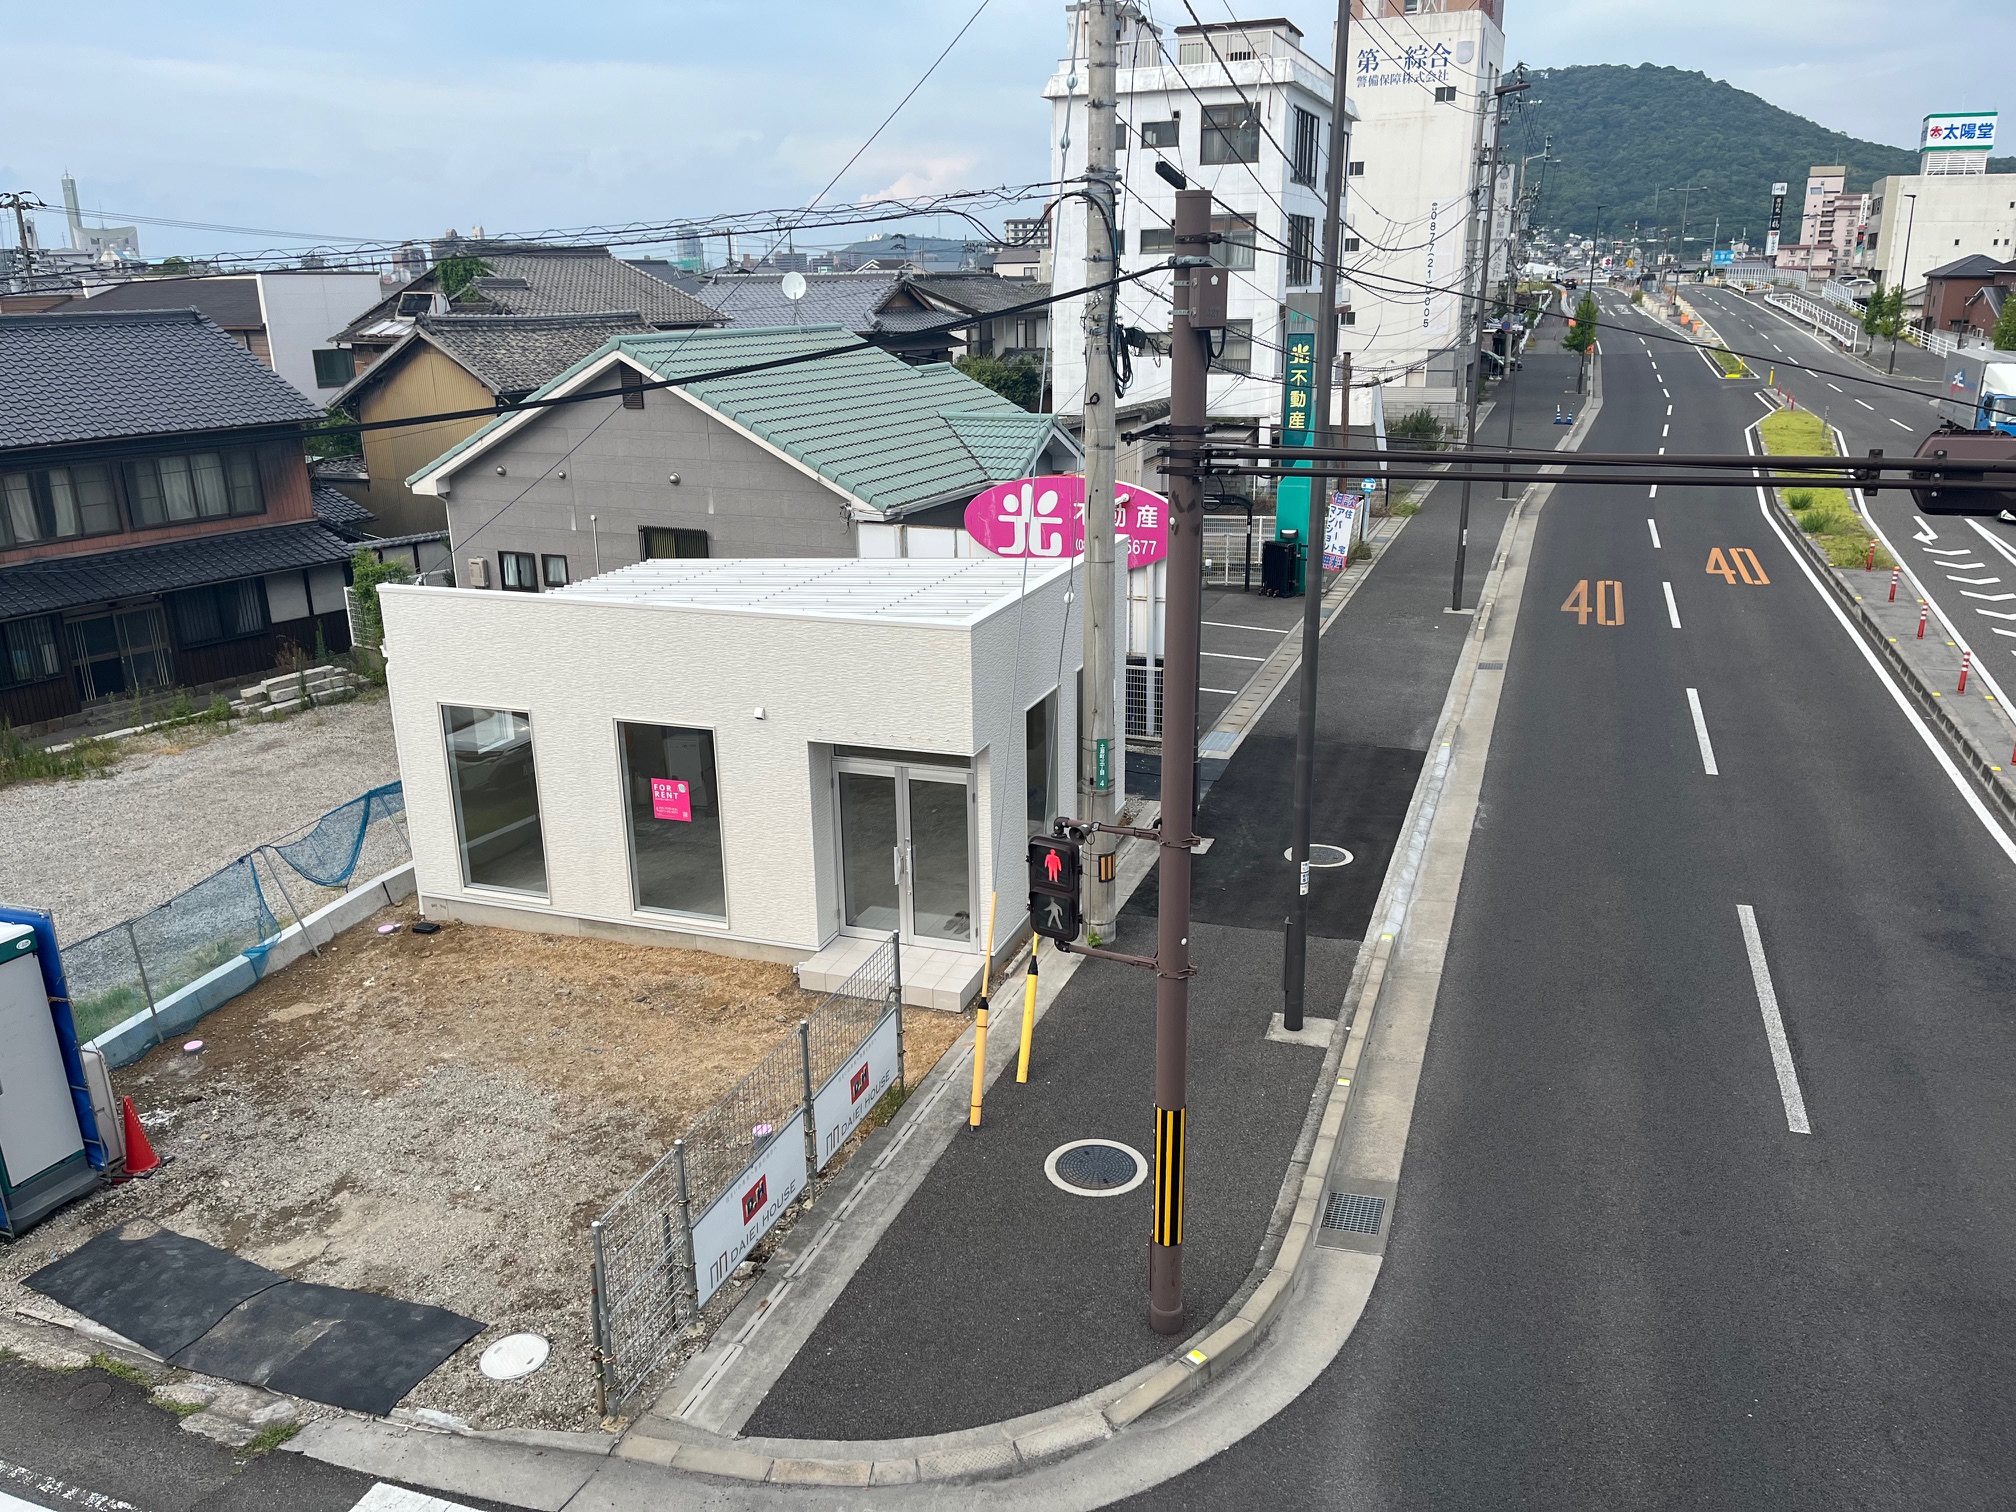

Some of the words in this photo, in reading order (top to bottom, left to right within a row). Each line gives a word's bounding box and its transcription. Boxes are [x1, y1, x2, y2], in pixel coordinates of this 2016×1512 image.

[1357, 42, 1452, 74] 第一綜合
[1356, 69, 1449, 88] 警備保障株式会社
[1943, 122, 1995, 140] 太陽堂
[1288, 343, 1311, 429] 光不動産
[997, 483, 1063, 556] 光
[1705, 547, 1771, 585] 40
[1560, 579, 1626, 626] 40
[653, 783, 672, 792] FOR
[654, 790, 679, 800] RENT
[841, 1105, 863, 1137] DAIEI
[864, 1069, 891, 1108] HOUSE
[730, 1221, 759, 1264] DAIEI
[762, 1178, 797, 1225] HOUSE
